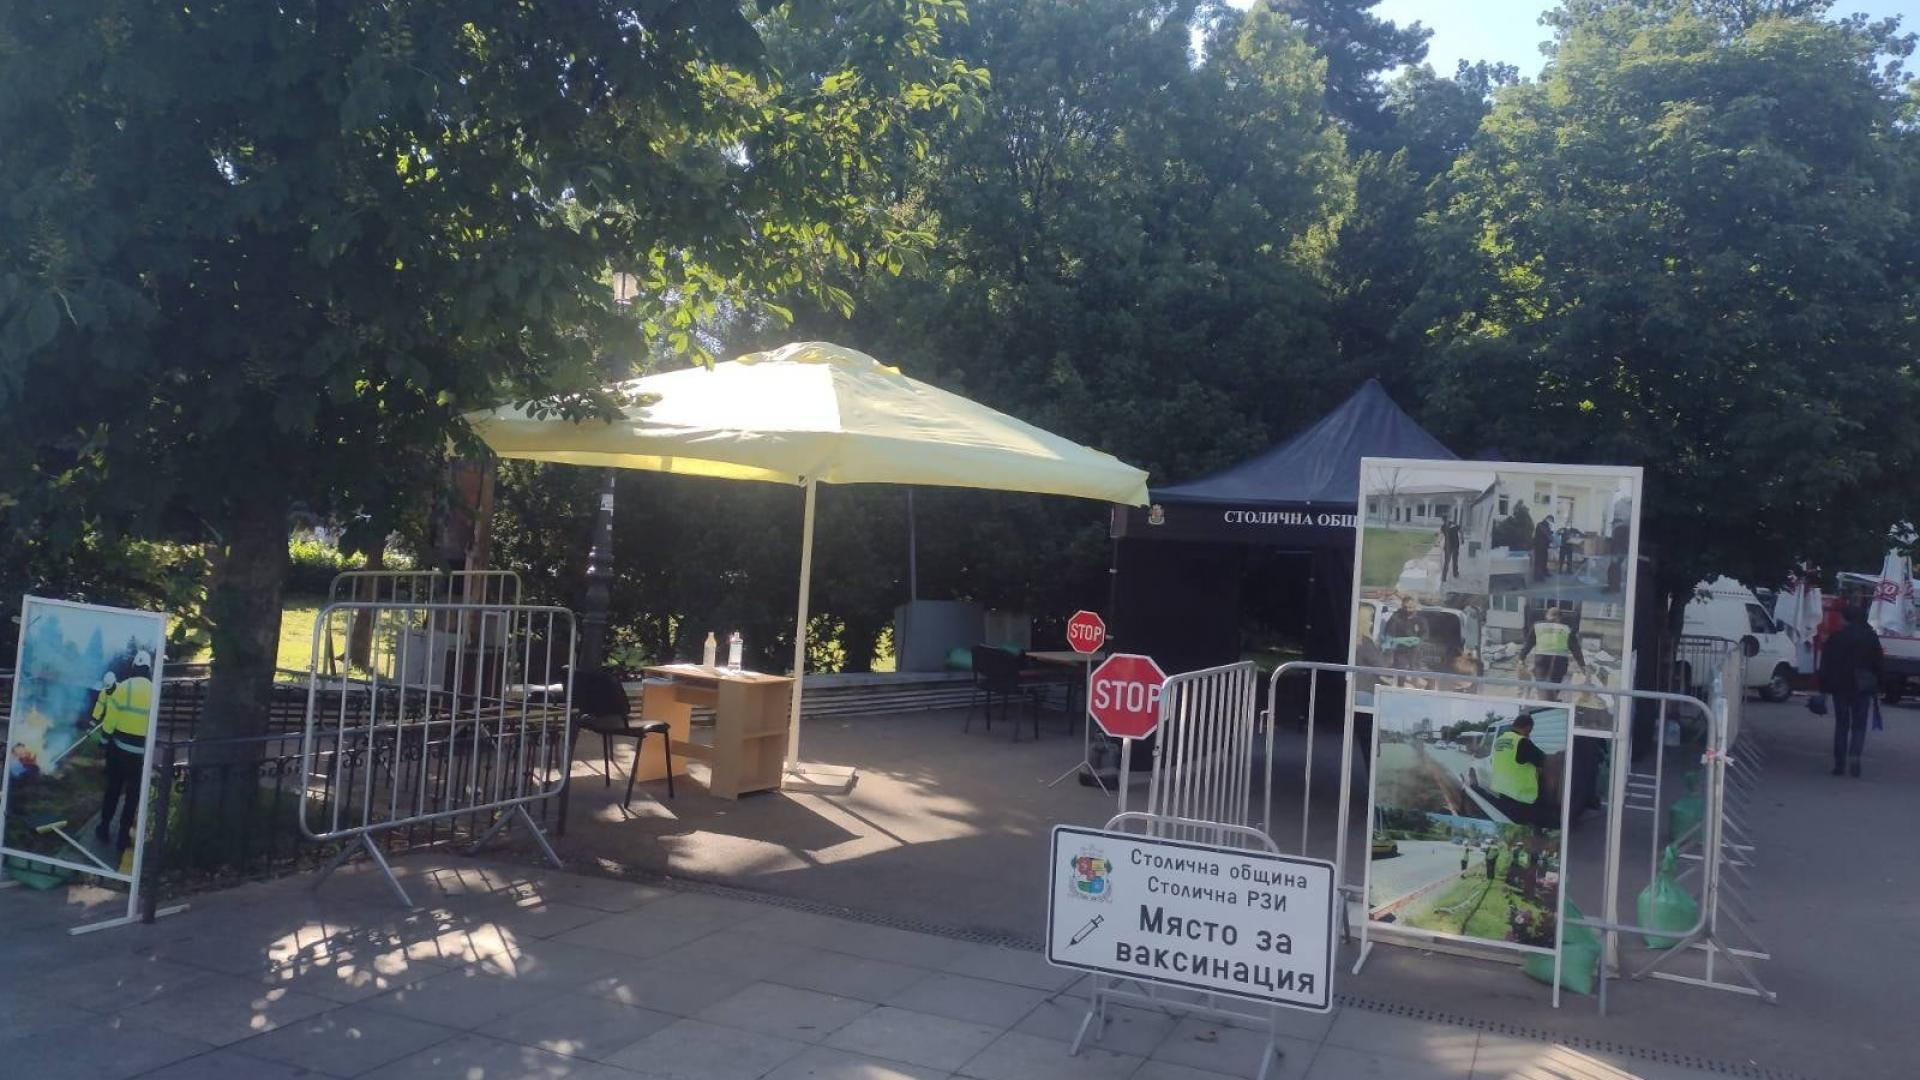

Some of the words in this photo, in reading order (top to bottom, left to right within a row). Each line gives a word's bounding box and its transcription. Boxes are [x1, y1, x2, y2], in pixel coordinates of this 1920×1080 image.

[1224, 510, 1313, 525] СТОЛИЧНА
[1070, 623, 1102, 641] STOP
[1095, 679, 1161, 714] STOP
[1131, 849, 1219, 876] Столична
[1230, 865, 1308, 889] община
[1148, 876, 1237, 905] Столична
[1247, 890, 1287, 912] РЗИ
[1139, 904, 1238, 946] Място
[1255, 930, 1292, 955] за
[1116, 941, 1315, 994] ваксинация
